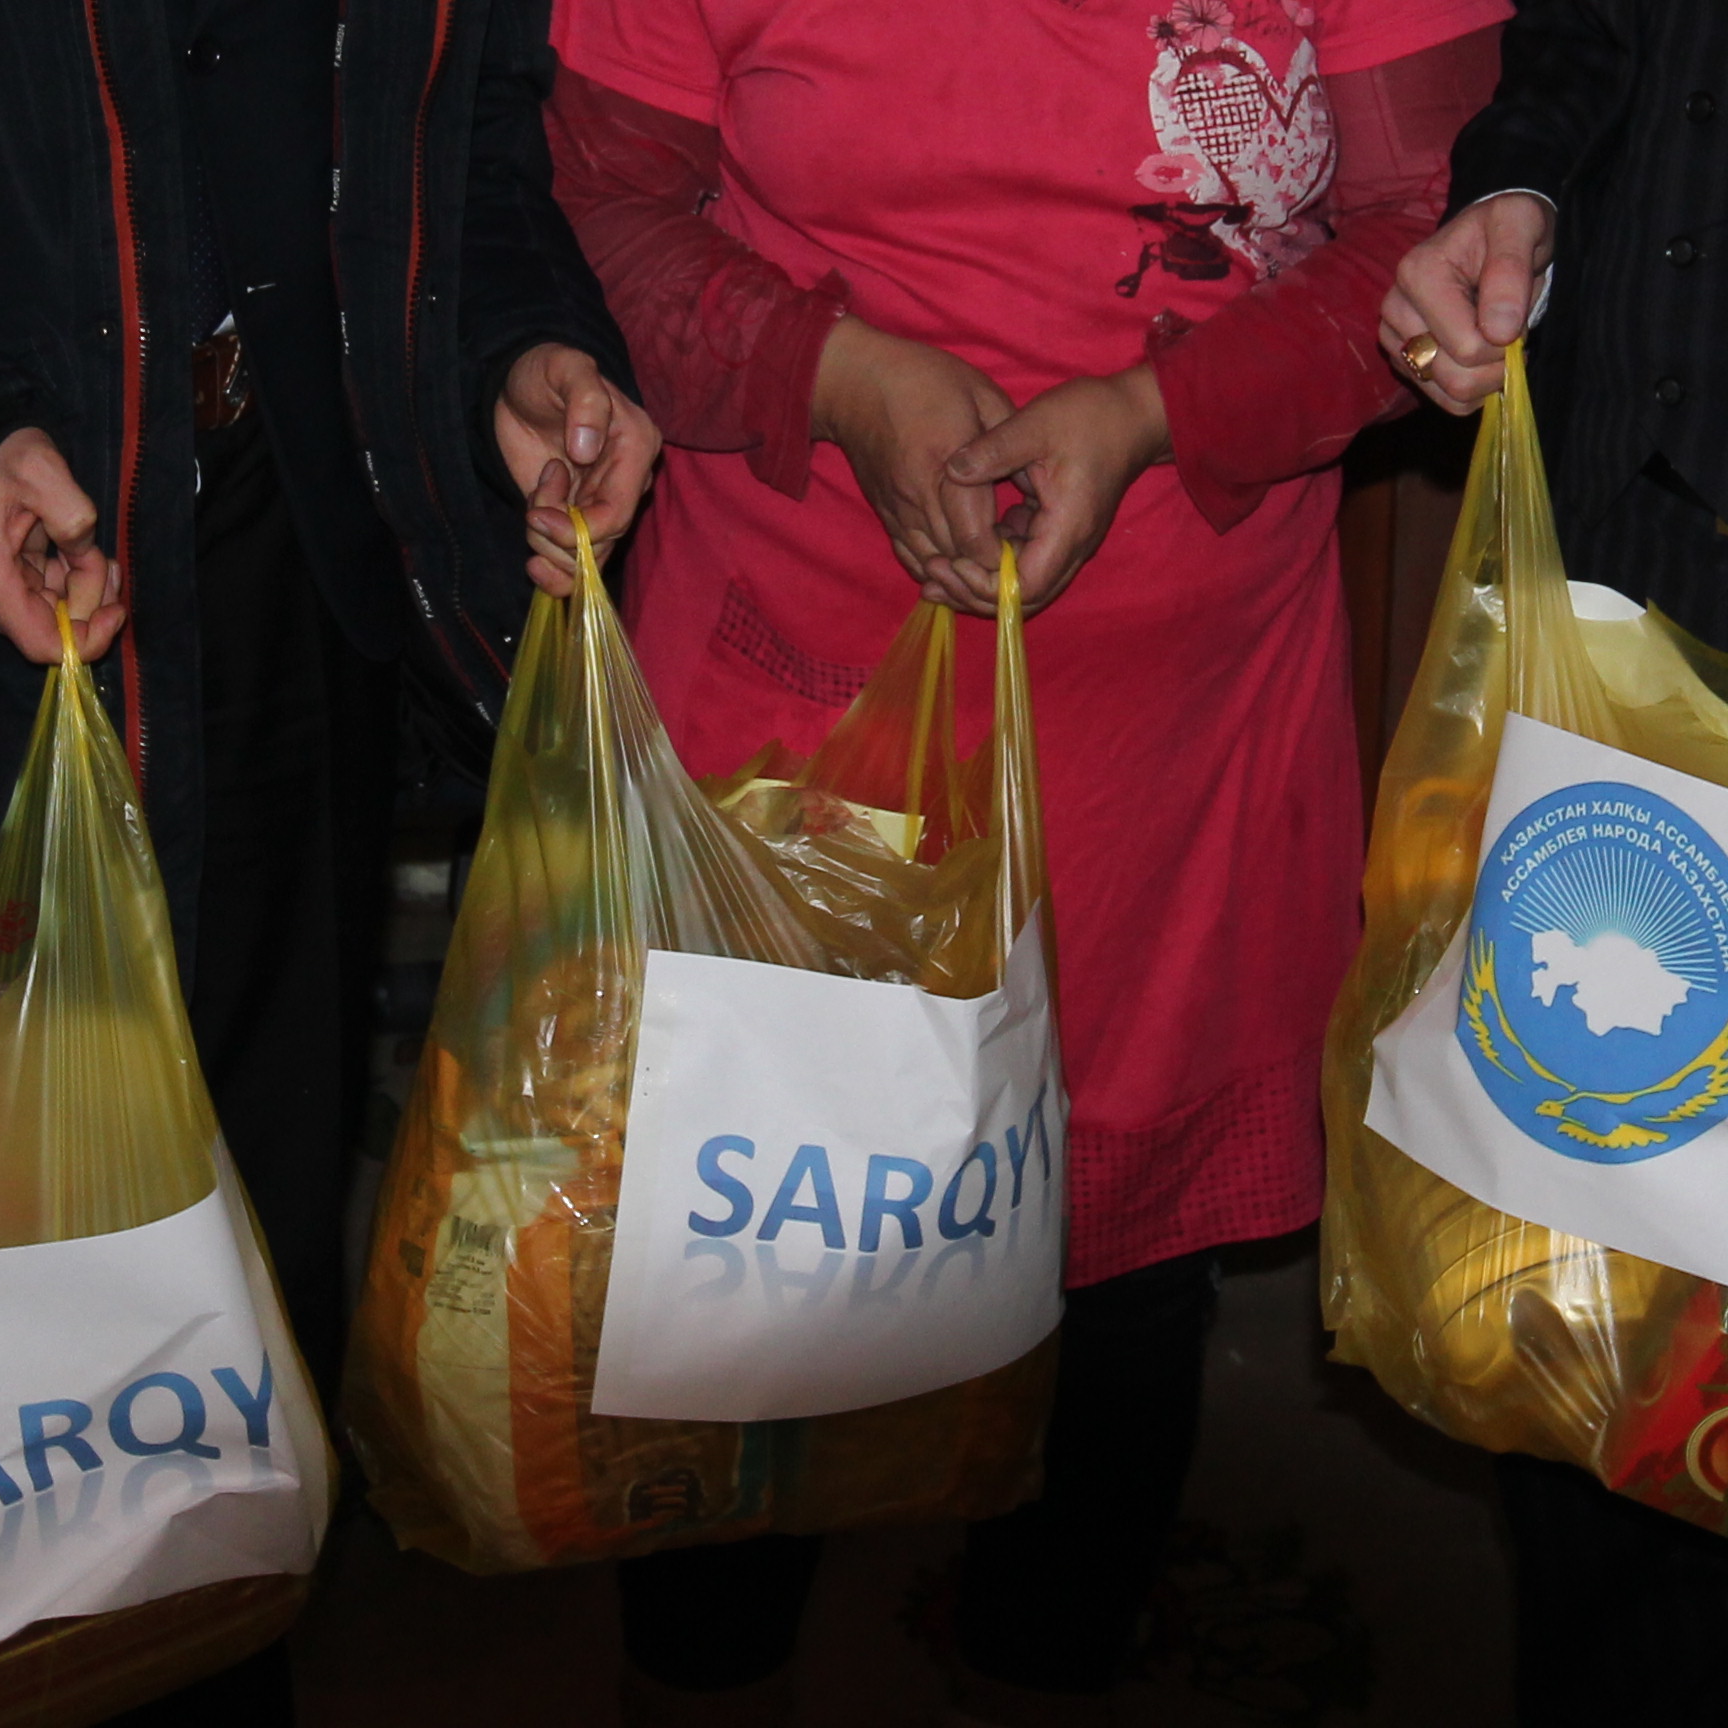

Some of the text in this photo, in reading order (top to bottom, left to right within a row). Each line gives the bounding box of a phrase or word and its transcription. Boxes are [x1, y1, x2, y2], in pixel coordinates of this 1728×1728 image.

[1500, 802, 1586, 866] ҚАЗАҚСТАН
[1591, 800, 1651, 825] ХАЛҚЫ
[1501, 825, 1588, 904] АССАМБЛЕЯ
[1592, 823, 1663, 854] НАРОДА
